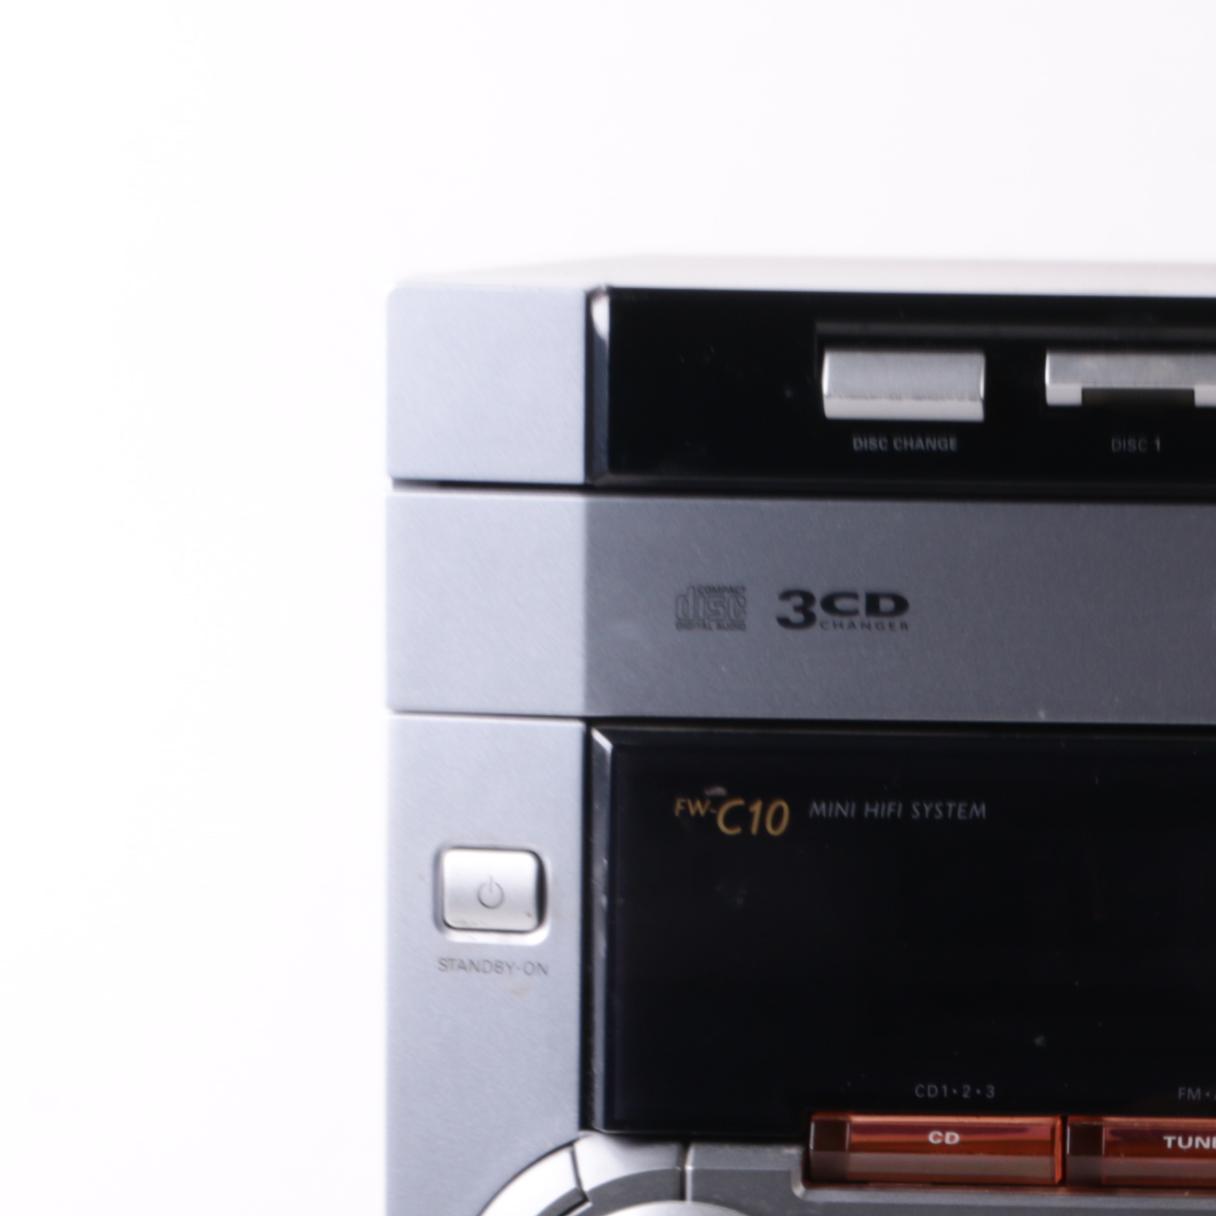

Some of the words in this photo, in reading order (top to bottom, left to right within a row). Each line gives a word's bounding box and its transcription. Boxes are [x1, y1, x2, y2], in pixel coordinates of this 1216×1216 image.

[852, 436, 888, 452] DISC
[892, 436, 958, 452] CHANGE
[1111, 437, 1148, 453] DISC
[1154, 437, 1161, 453] 1
[820, 620, 908, 632] CHANGER
[808, 801, 856, 819] MINI
[863, 801, 902, 820] HIFI
[911, 801, 986, 820] SYSTEM
[928, 1131, 960, 1145] CD
